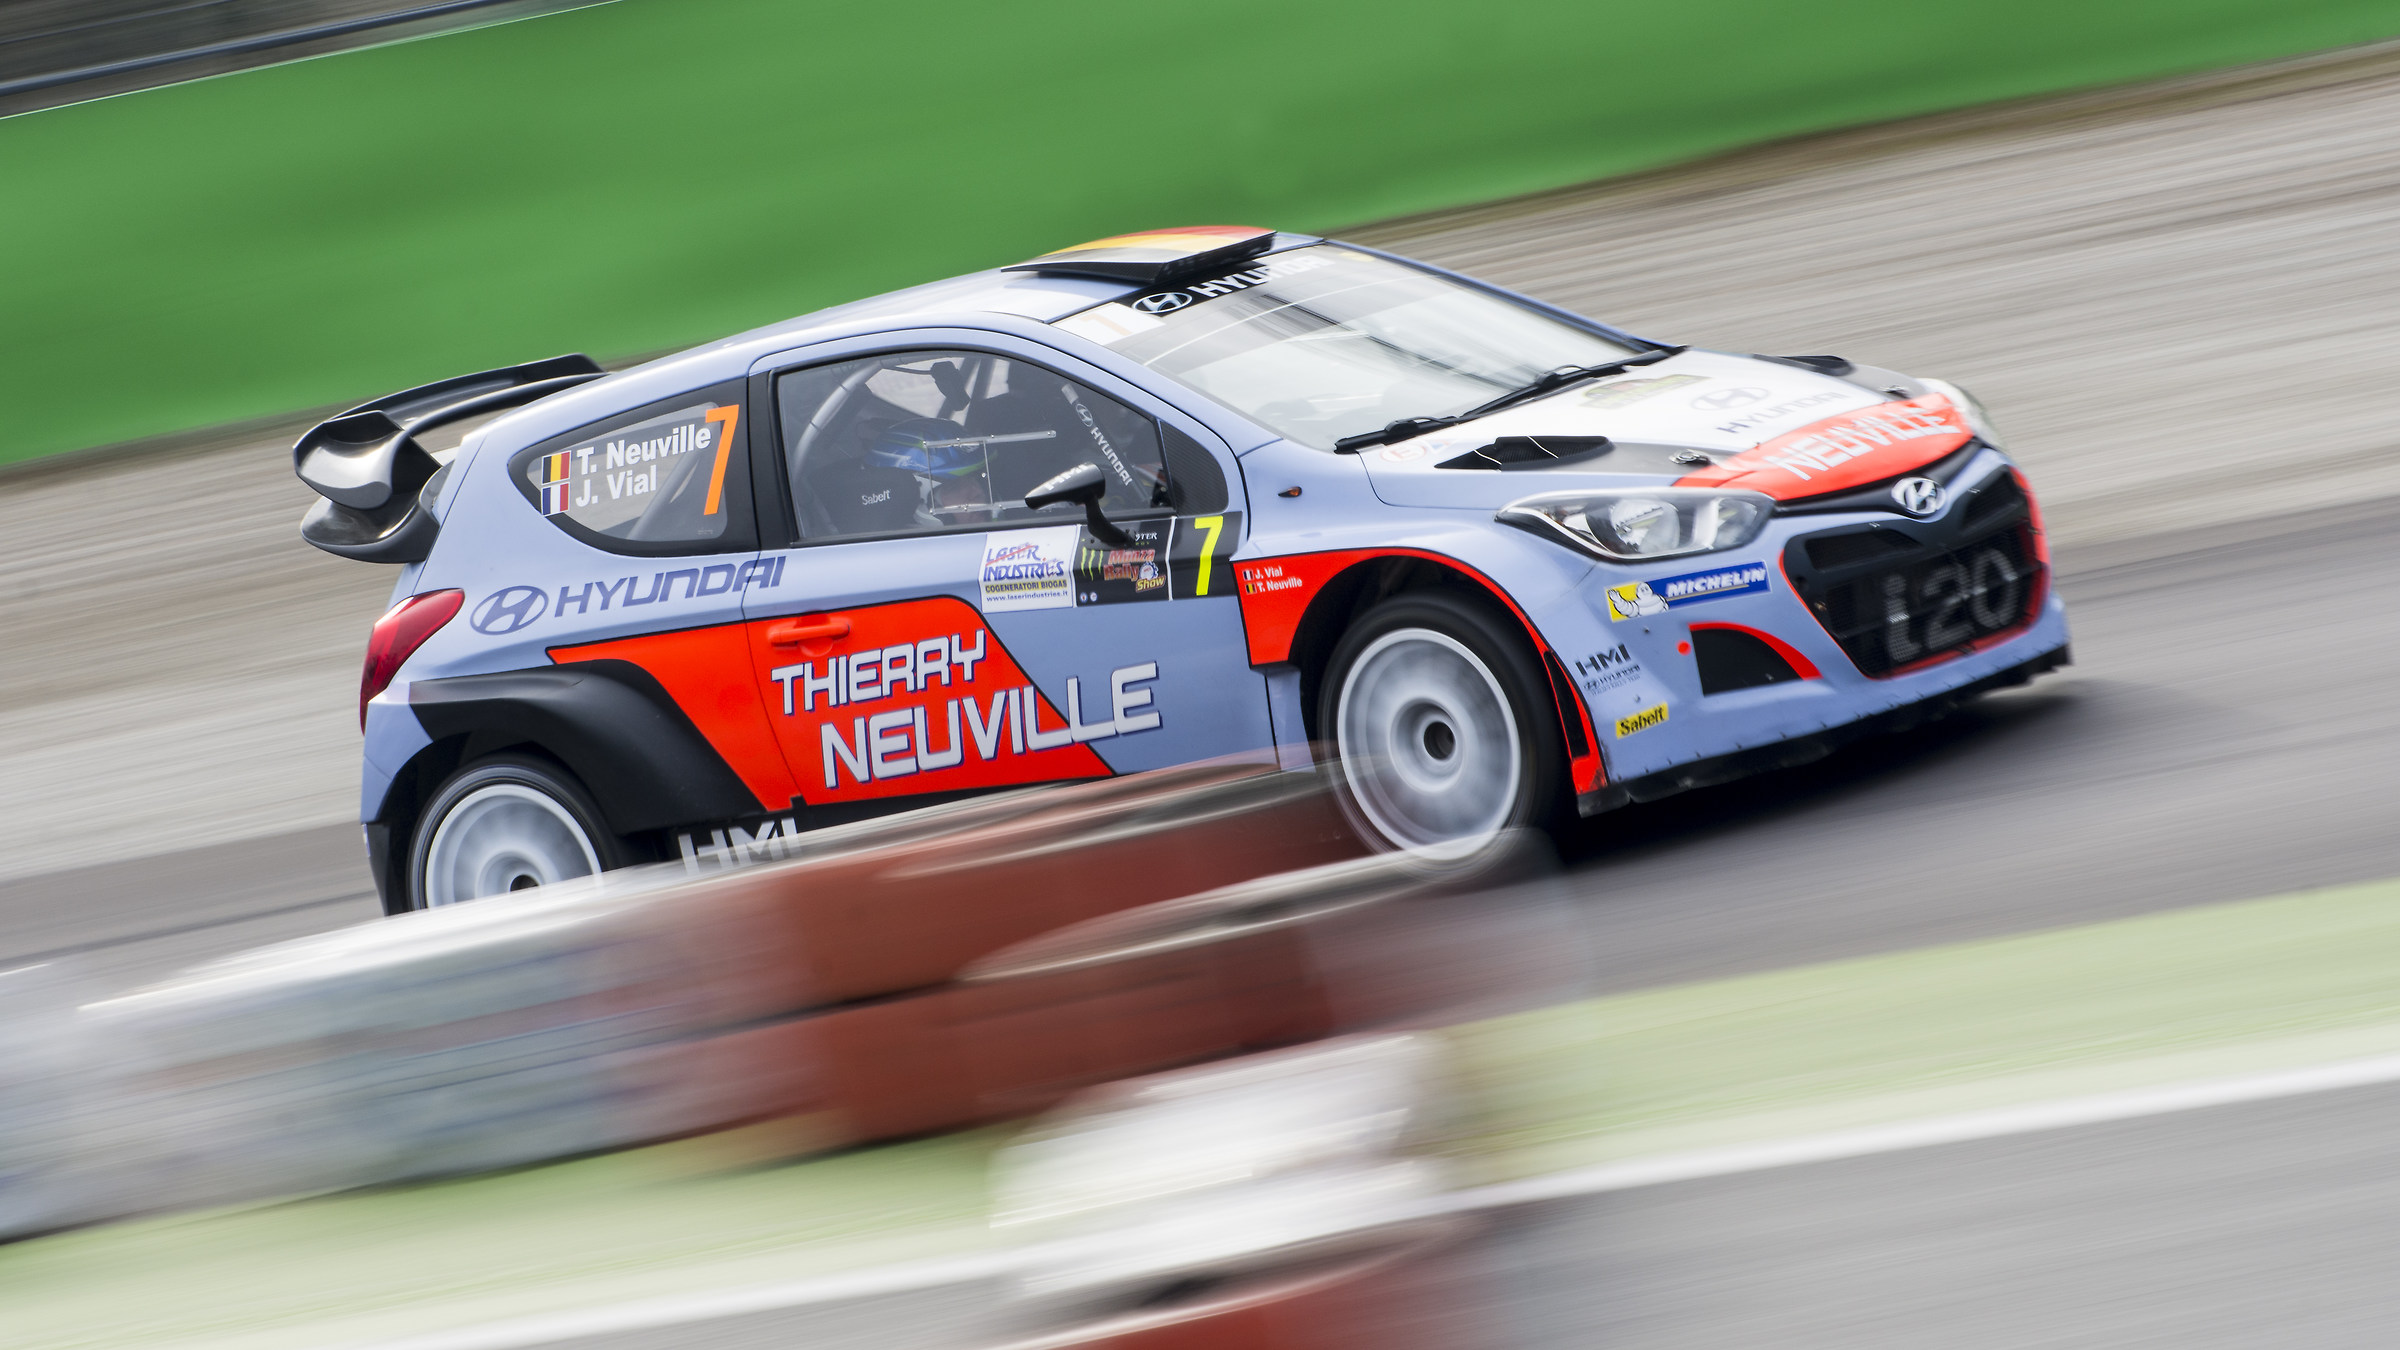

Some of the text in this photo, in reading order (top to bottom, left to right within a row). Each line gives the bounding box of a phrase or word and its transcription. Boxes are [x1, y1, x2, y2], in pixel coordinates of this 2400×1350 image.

[1715, 391, 1850, 434] HYUNDAI
[576, 424, 711, 475] T. Neuville
[704, 404, 739, 516] 7
[1090, 427, 1133, 486] HYUNDAI
[1763, 407, 1962, 481] NEUVILLE
[575, 465, 657, 507] J. Vial
[861, 489, 891, 506] Sabelt
[986, 543, 1042, 564] LASER
[1108, 549, 1156, 565] Monza
[1194, 516, 1223, 596] 7
[554, 556, 786, 618] HYUNDAI
[983, 560, 1064, 582] INDUSTRIES
[985, 580, 1067, 593] COGENERATORI BIOGAS
[1104, 563, 1140, 582] Rally
[1136, 576, 1166, 592] Show
[1255, 566, 1283, 579] J. Vial
[1256, 576, 1303, 592] T. Neuville
[1666, 567, 1766, 598] MICHELIN
[986, 591, 1068, 602] www.laserindustries.it
[771, 629, 987, 715] THIERRY
[1575, 643, 1631, 678] HMI
[820, 661, 1162, 789] NEUVILLE
[1620, 706, 1665, 737] Sabelt
[678, 816, 801, 876] HMI
